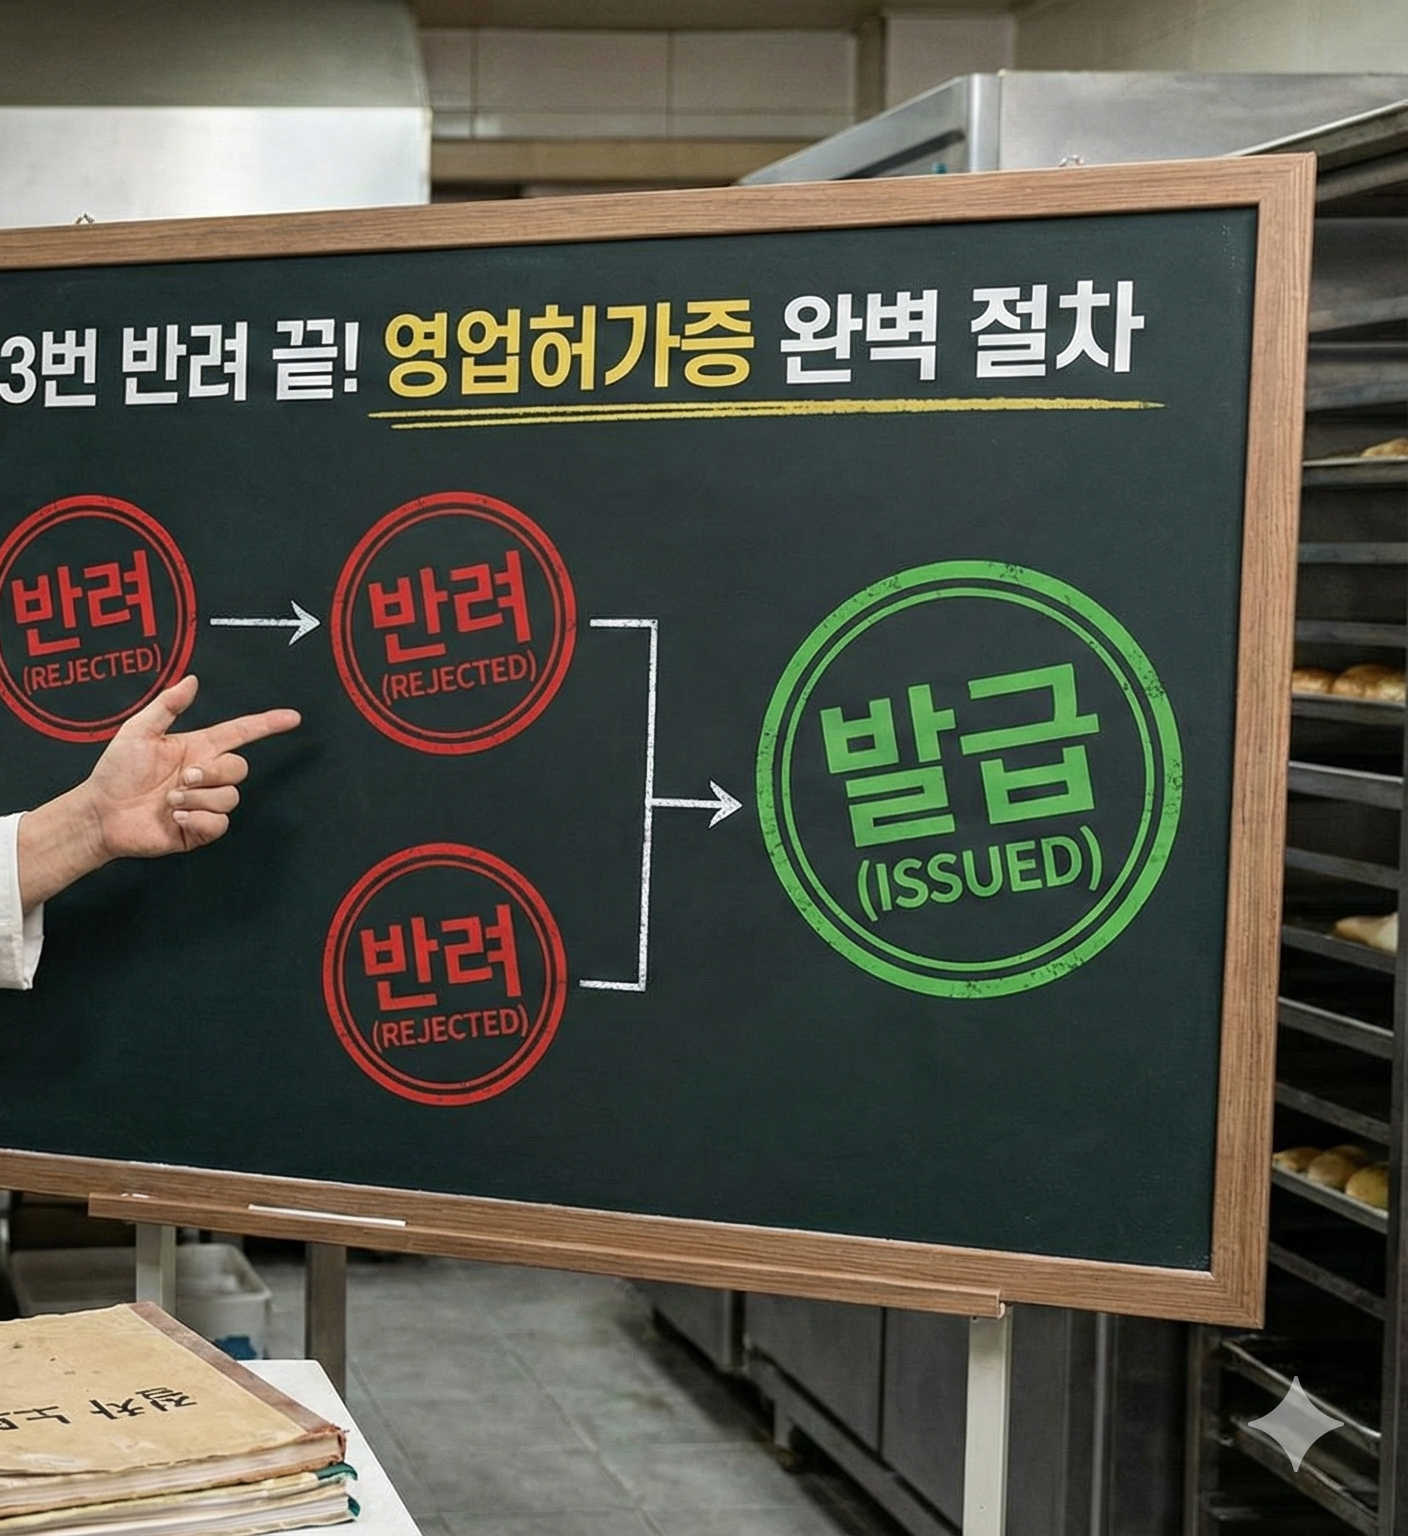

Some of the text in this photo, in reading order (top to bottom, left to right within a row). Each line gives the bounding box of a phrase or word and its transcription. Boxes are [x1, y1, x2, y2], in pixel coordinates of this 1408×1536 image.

[122, 321, 249, 405] 반려
[272, 319, 360, 401] 끝!
[385, 299, 755, 398] 영업허가증
[780, 289, 938, 385] 완벽
[970, 280, 1145, 378] 절차
[12, 550, 156, 656] 반려
[368, 550, 531, 663] 반려
[22, 646, 161, 695] (REJECTED)
[383, 650, 536, 705] (REJECTED)
[820, 663, 1100, 848] 발급
[858, 826, 1104, 922] (ISSUED)
[360, 904, 522, 1011] 반려
[373, 1004, 529, 1053] (REJECTED)
[90, 1386, 198, 1421] 절차
